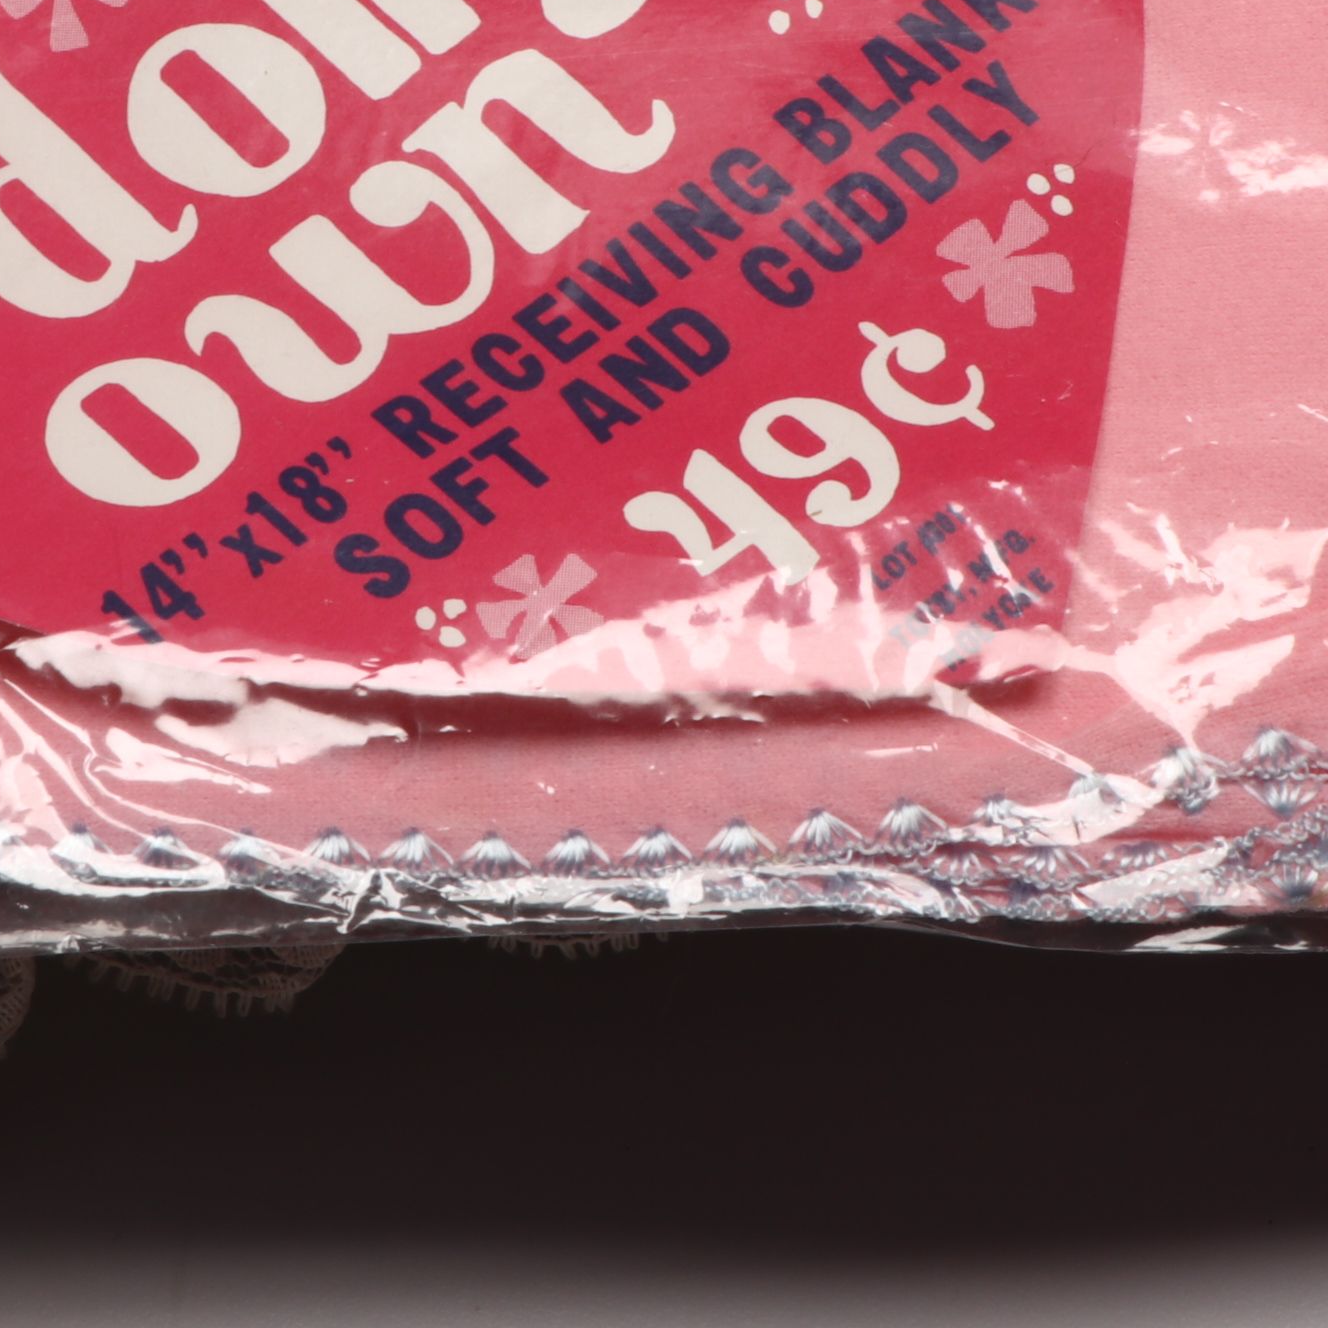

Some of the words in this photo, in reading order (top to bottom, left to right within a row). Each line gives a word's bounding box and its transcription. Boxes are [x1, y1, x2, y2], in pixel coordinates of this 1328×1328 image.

[46, 49, 676, 507] own
[333, 426, 550, 600] SOFT
[559, 307, 731, 445] AND
[740, 61, 1039, 309] CUDDLY
[370, 147, 794, 460] RECEIVING
[624, 322, 994, 586] 49¢
[871, 540, 918, 592] LOT
